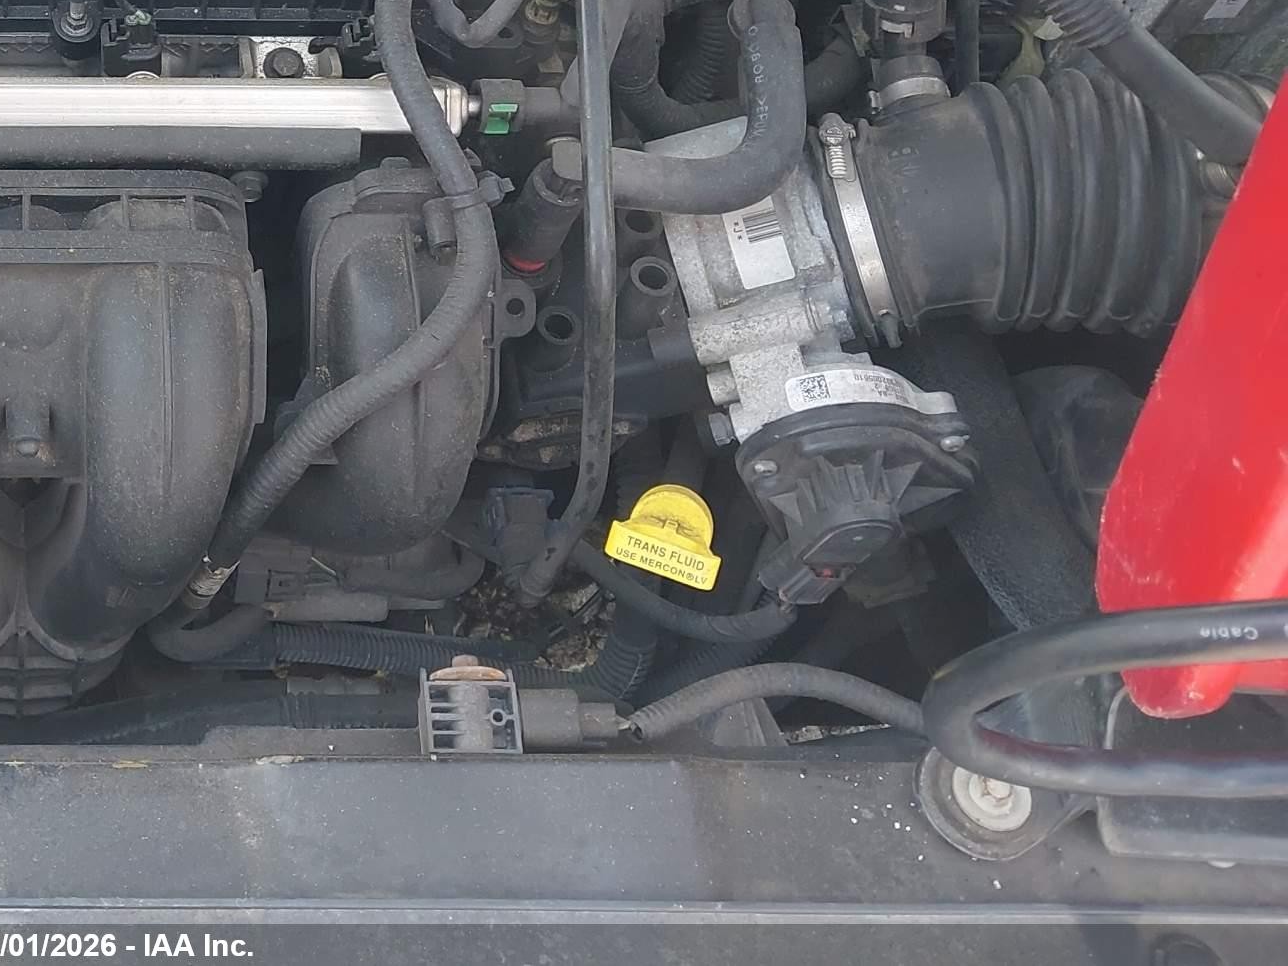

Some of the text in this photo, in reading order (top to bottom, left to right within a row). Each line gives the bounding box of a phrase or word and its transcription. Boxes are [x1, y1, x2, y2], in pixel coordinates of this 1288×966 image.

[615, 547, 637, 560] USE
[627, 535, 705, 571] TRANS FLUID
